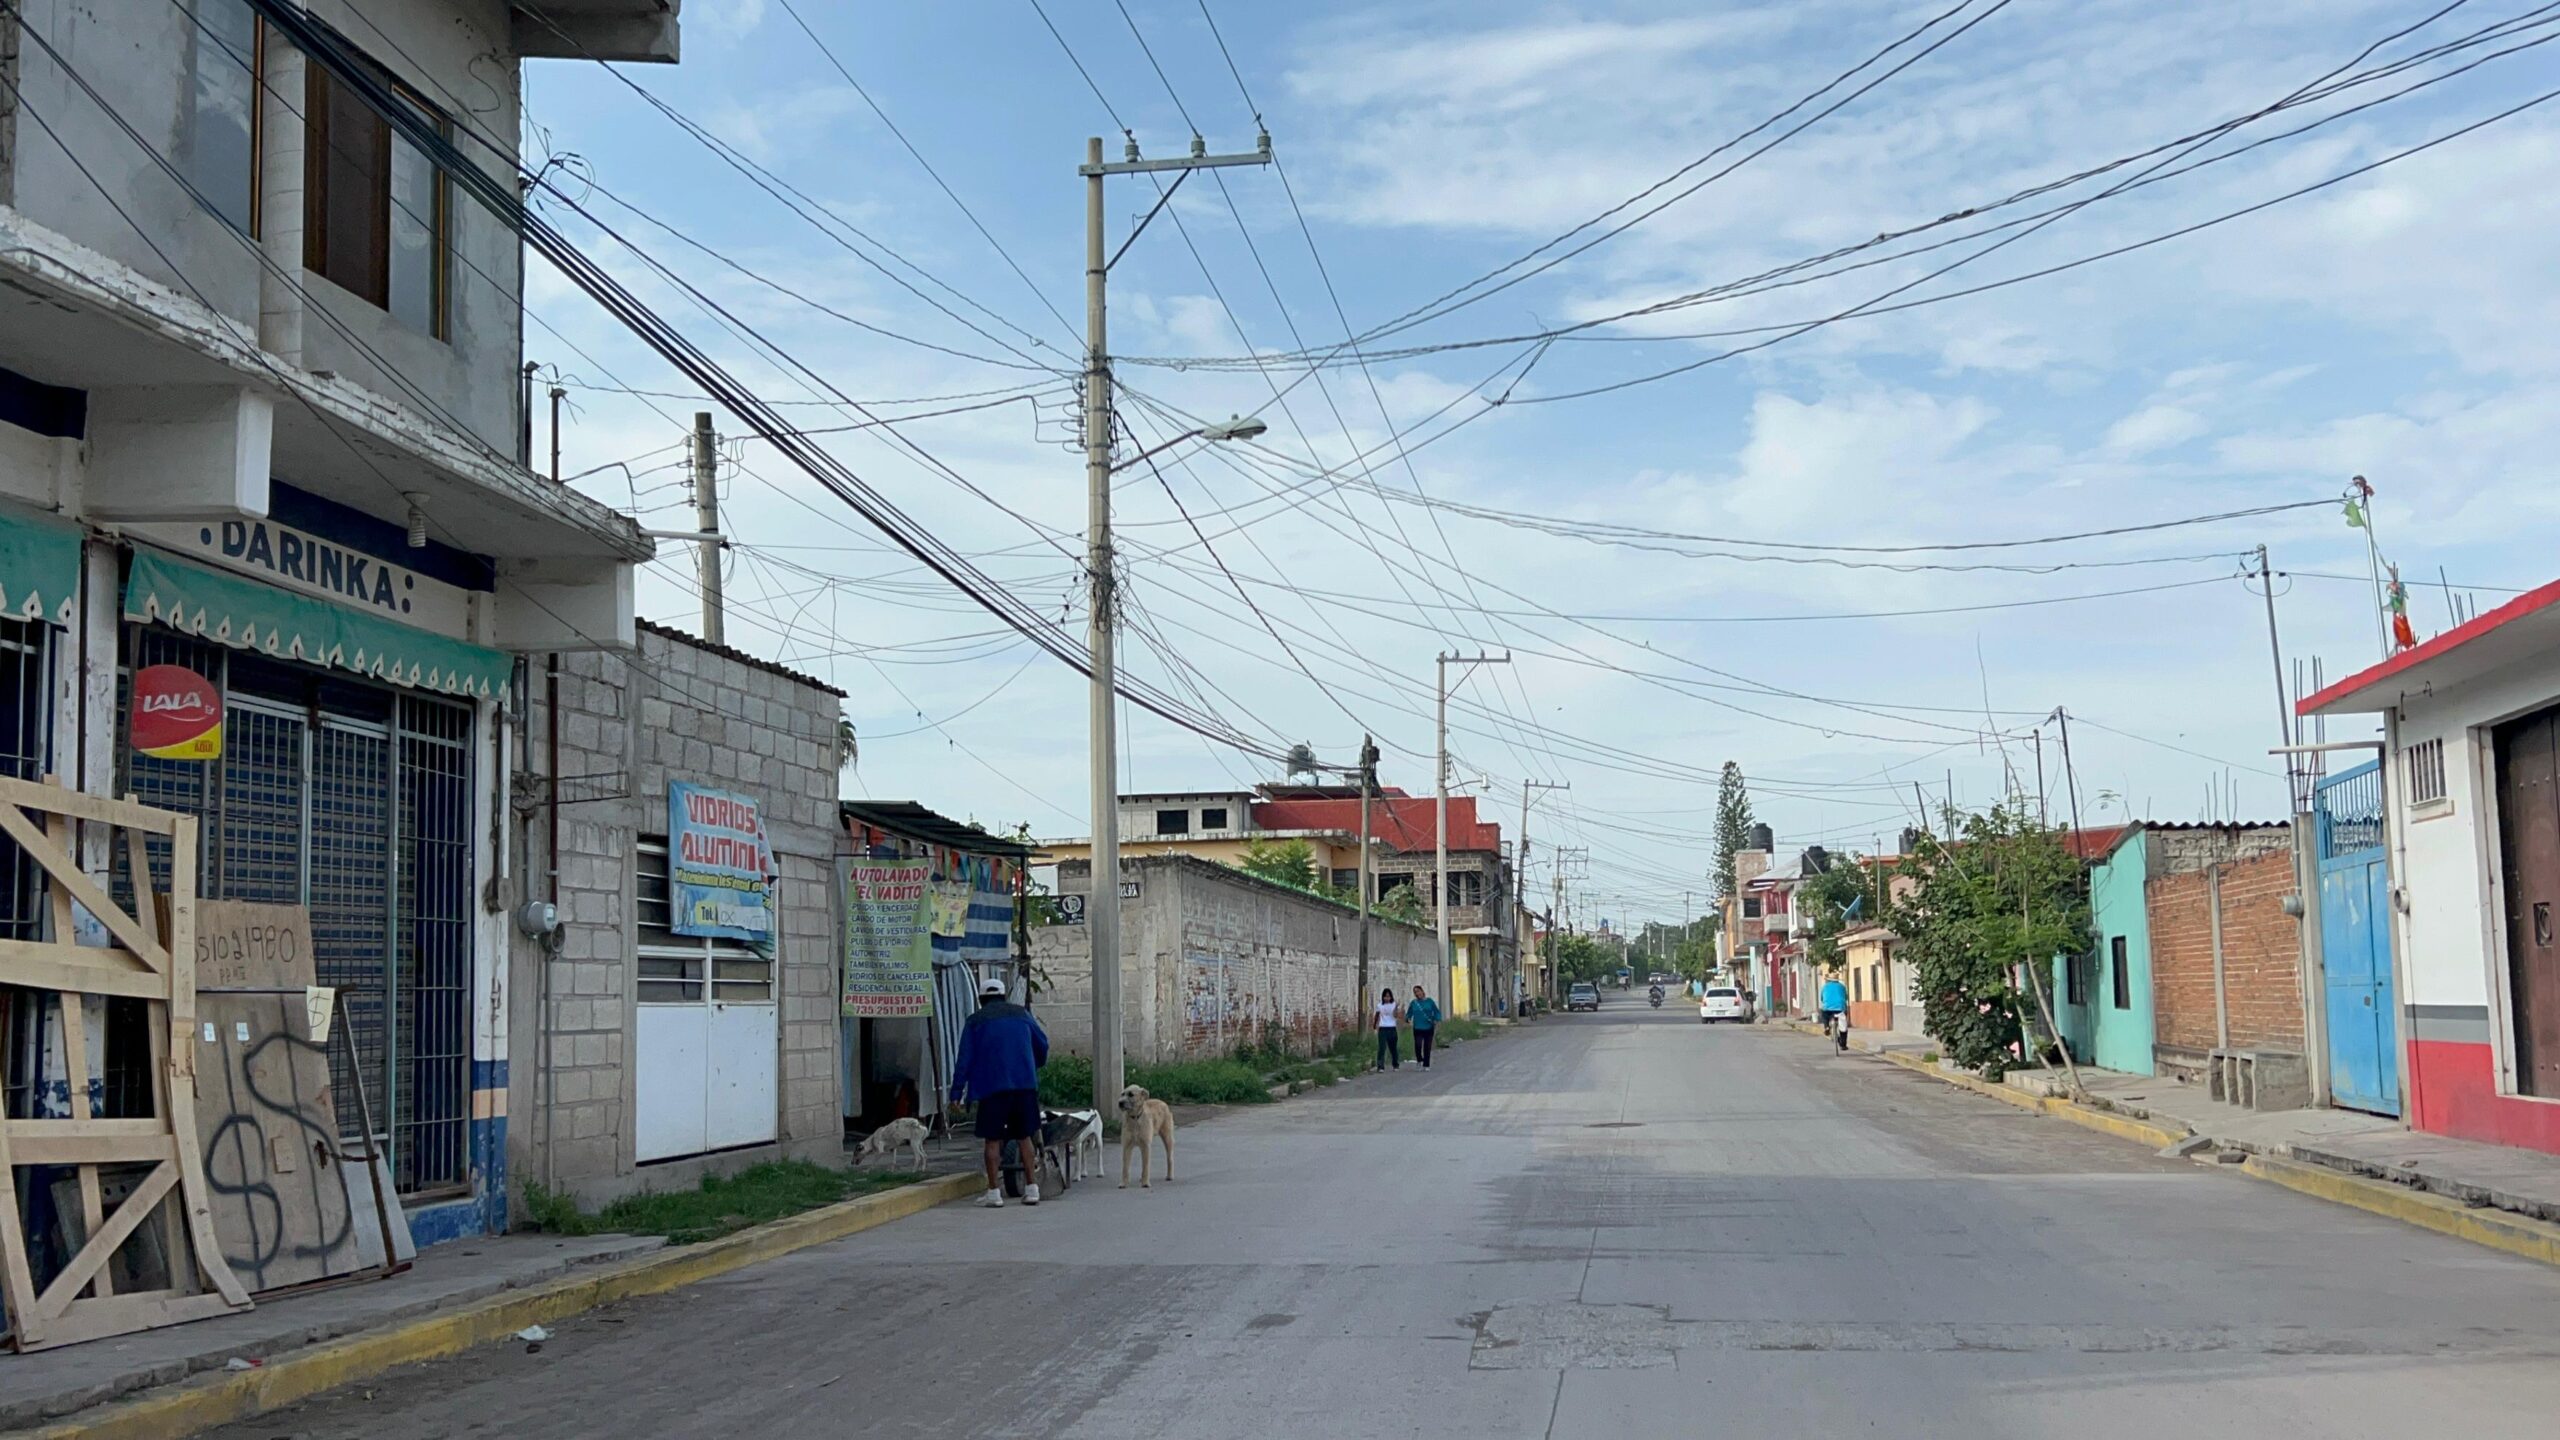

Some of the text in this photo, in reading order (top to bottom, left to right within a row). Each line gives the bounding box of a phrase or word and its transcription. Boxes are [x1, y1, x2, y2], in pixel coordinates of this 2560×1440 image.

[143, 691, 203, 713] LALA
[685, 792, 757, 835] VIDRIOS
[850, 867, 929, 883] AUTOLAVADO
[877, 915, 886, 924] DE
[888, 914, 912, 923] MOTOR
[876, 926, 885, 935] DE
[887, 925, 928, 935] VESTIDURAS
[885, 937, 912, 947] VIDRIOS
[879, 961, 910, 970] PULIMOS
[849, 972, 877, 980] VIDRIOS
[894, 984, 902, 992] EN
[845, 994, 913, 1005] PRESUPUESTO
[855, 1005, 874, 1015] 735
[876, 1005, 893, 1015] 251
